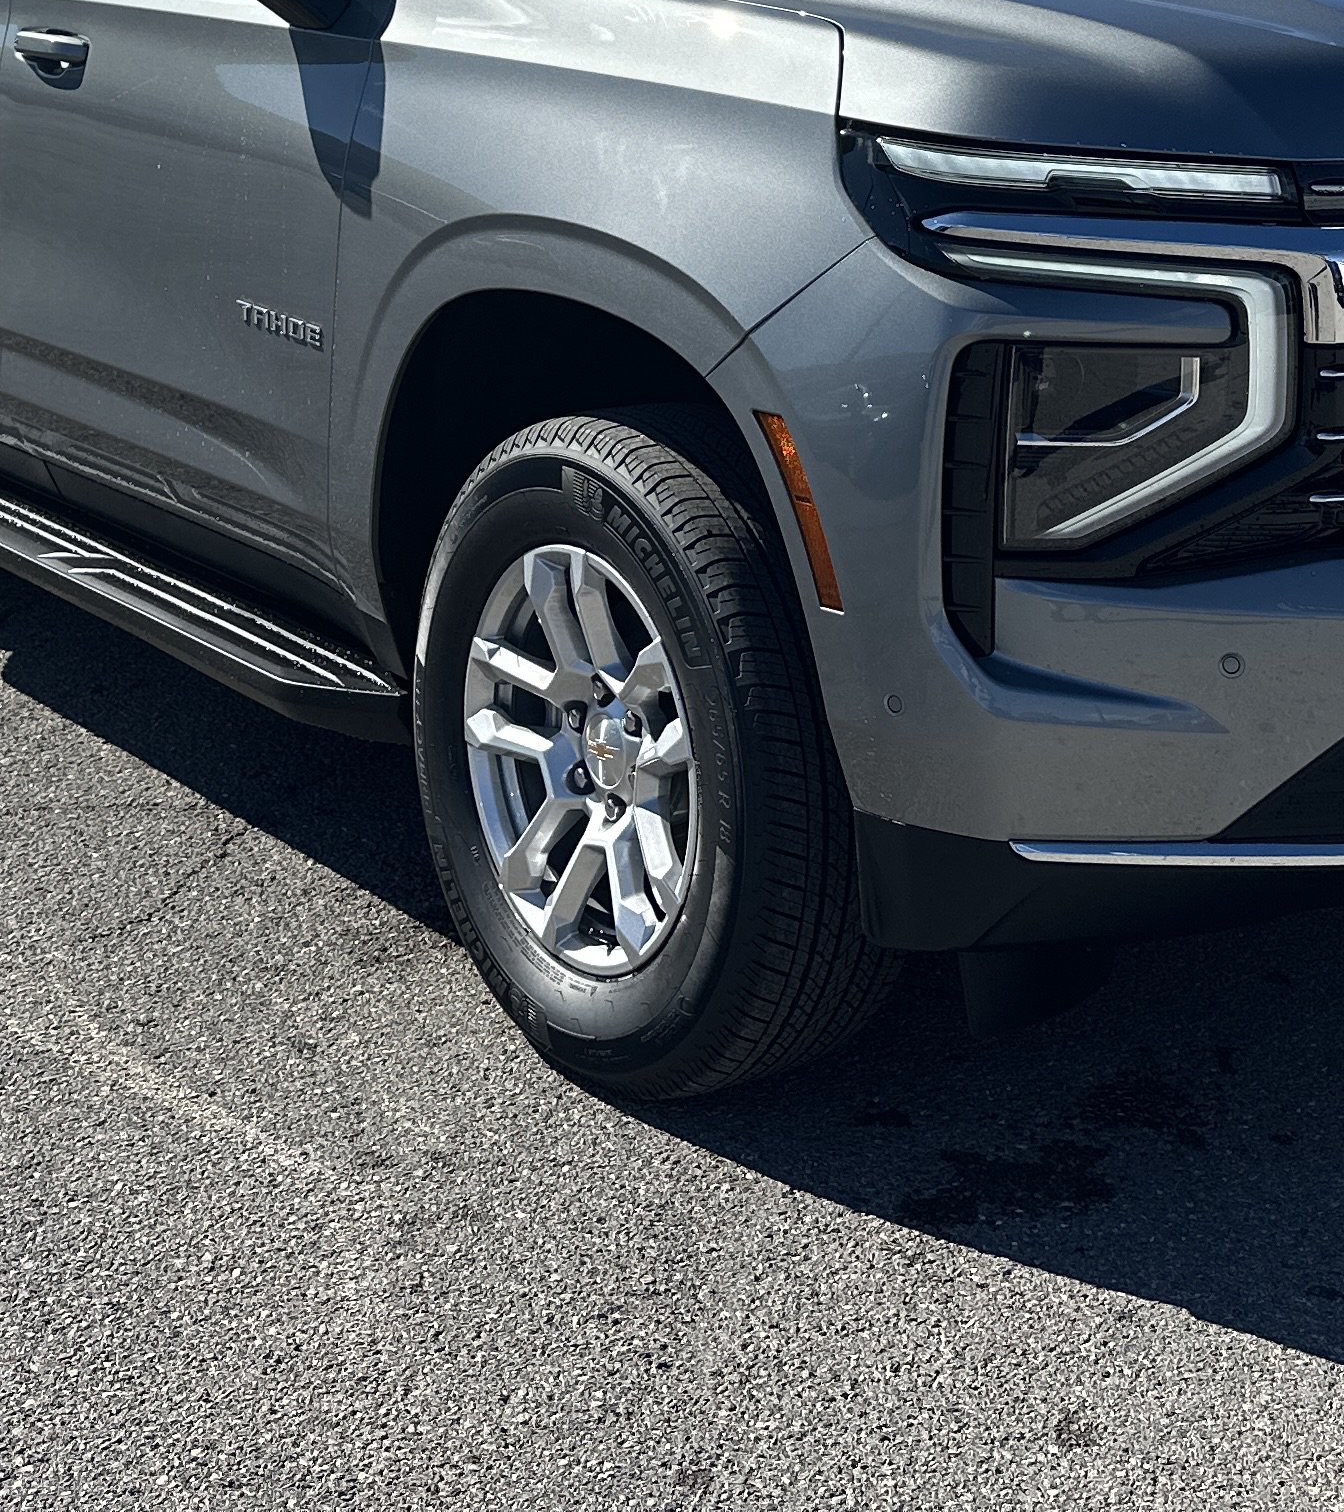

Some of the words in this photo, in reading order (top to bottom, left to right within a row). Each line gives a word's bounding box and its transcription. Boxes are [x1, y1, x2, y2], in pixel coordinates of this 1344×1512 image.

[235, 299, 322, 347] TAHOE
[605, 503, 703, 660] MICHELIN
[718, 790, 732, 809] R
[432, 842, 506, 999] MICHELIN
